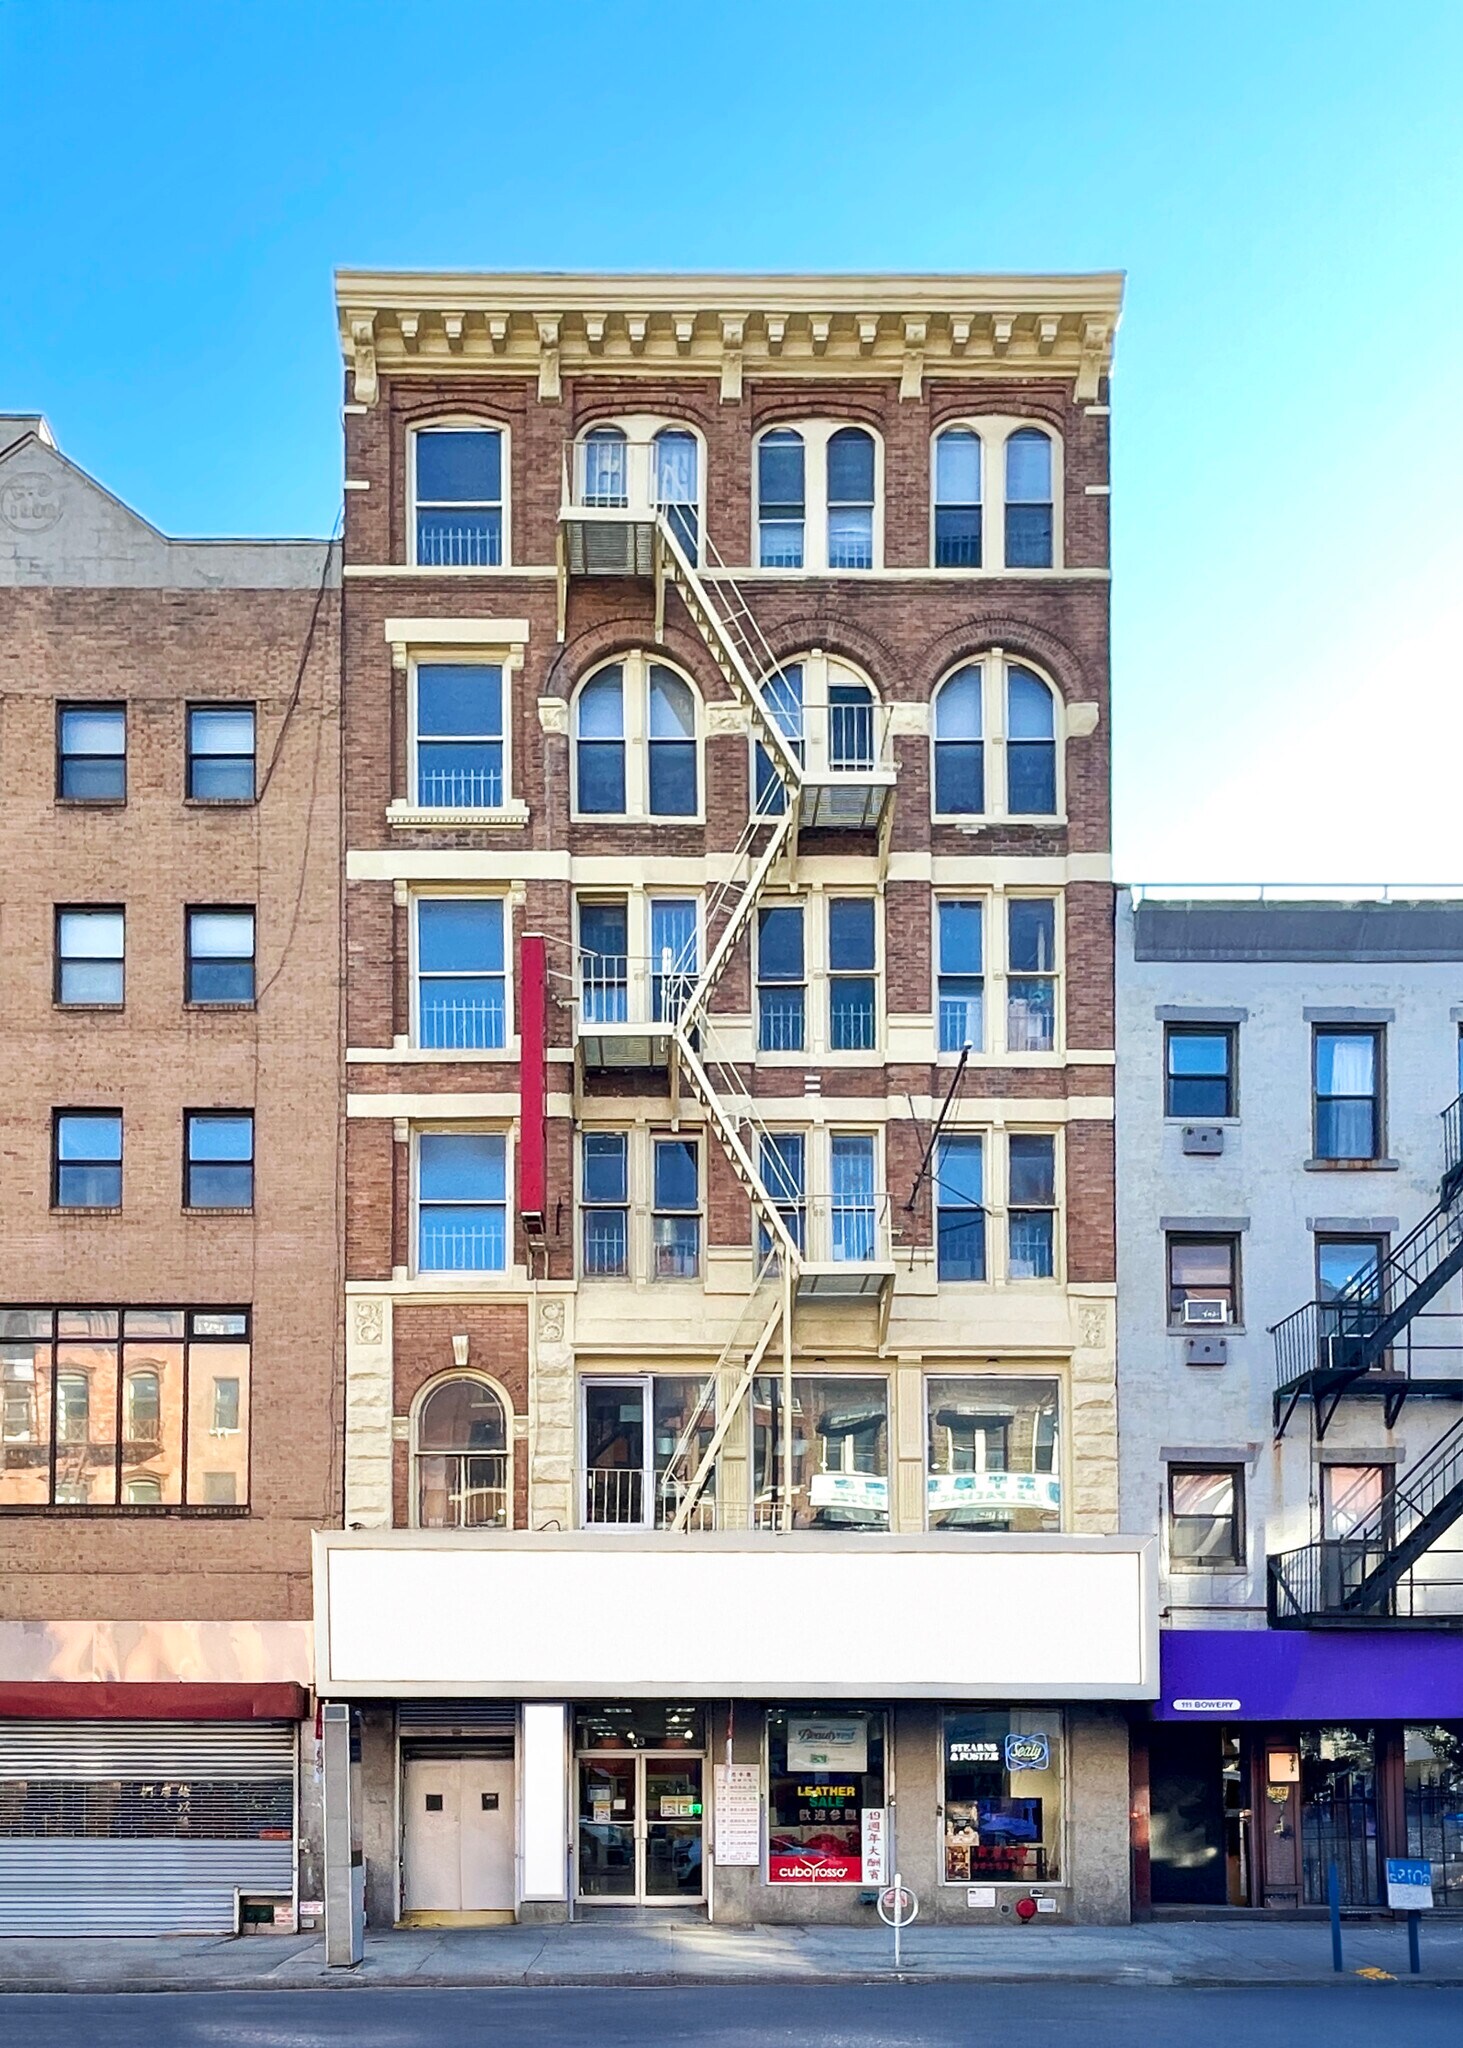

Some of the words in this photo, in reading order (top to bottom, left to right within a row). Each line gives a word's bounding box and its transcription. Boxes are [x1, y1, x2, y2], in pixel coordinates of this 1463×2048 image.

[1194, 1701, 1233, 1709] BOWERY
[950, 1743, 998, 1752] STEARNS
[1011, 1743, 1042, 1760] Sealy
[950, 1752, 959, 1761] &
[959, 1752, 999, 1761] FOSTER
[797, 1786, 855, 1796] LEATHER
[809, 1797, 844, 1807] SALE
